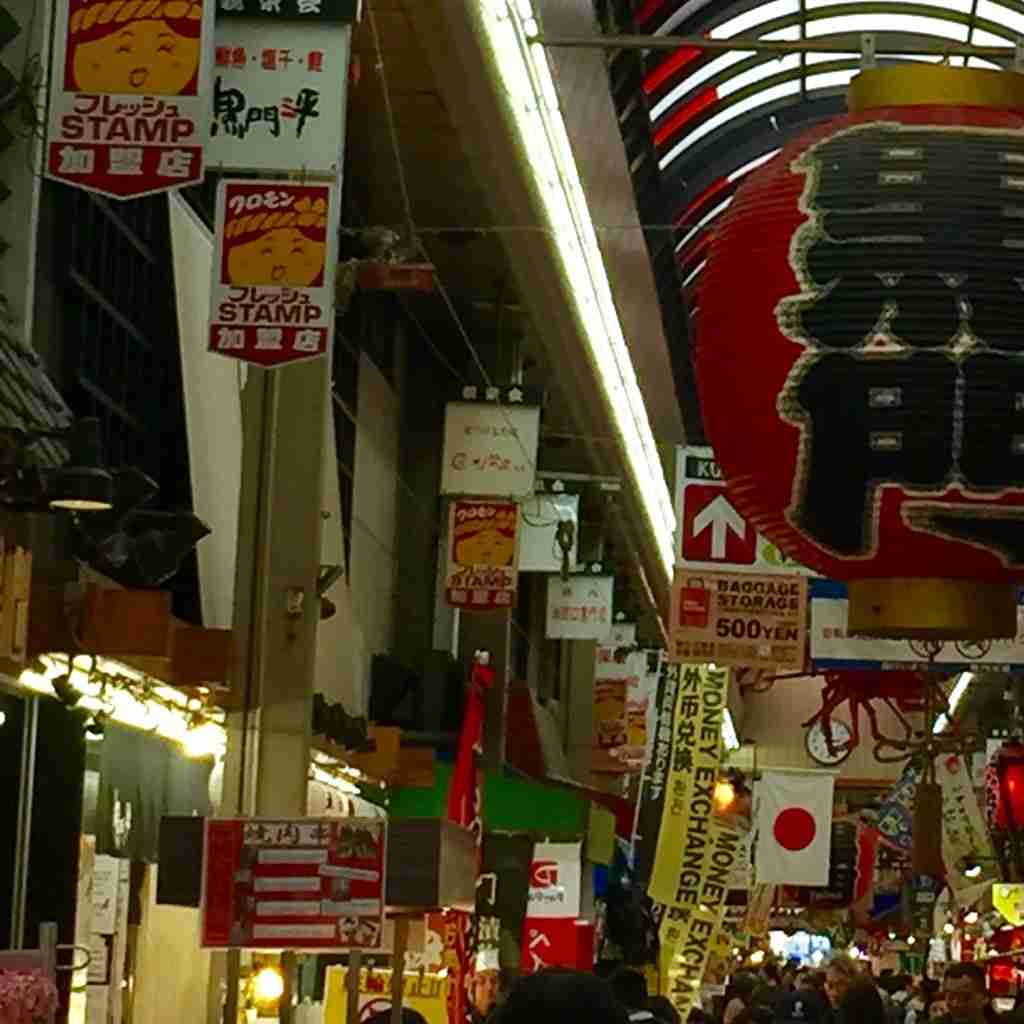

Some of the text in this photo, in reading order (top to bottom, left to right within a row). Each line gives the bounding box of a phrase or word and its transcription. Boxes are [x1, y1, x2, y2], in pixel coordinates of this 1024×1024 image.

[73, 95, 180, 116] フレッシュ
[60, 115, 195, 144] STAMP
[58, 147, 194, 177] 加盟店
[229, 191, 296, 215] クロモン
[218, 304, 322, 324] STAMP
[717, 579, 800, 595] BAGGAGE
[717, 594, 799, 610] STORAGE
[699, 671, 726, 761] MONEY
[676, 767, 715, 903] EXCHANGE
[702, 831, 739, 915] MONEY
